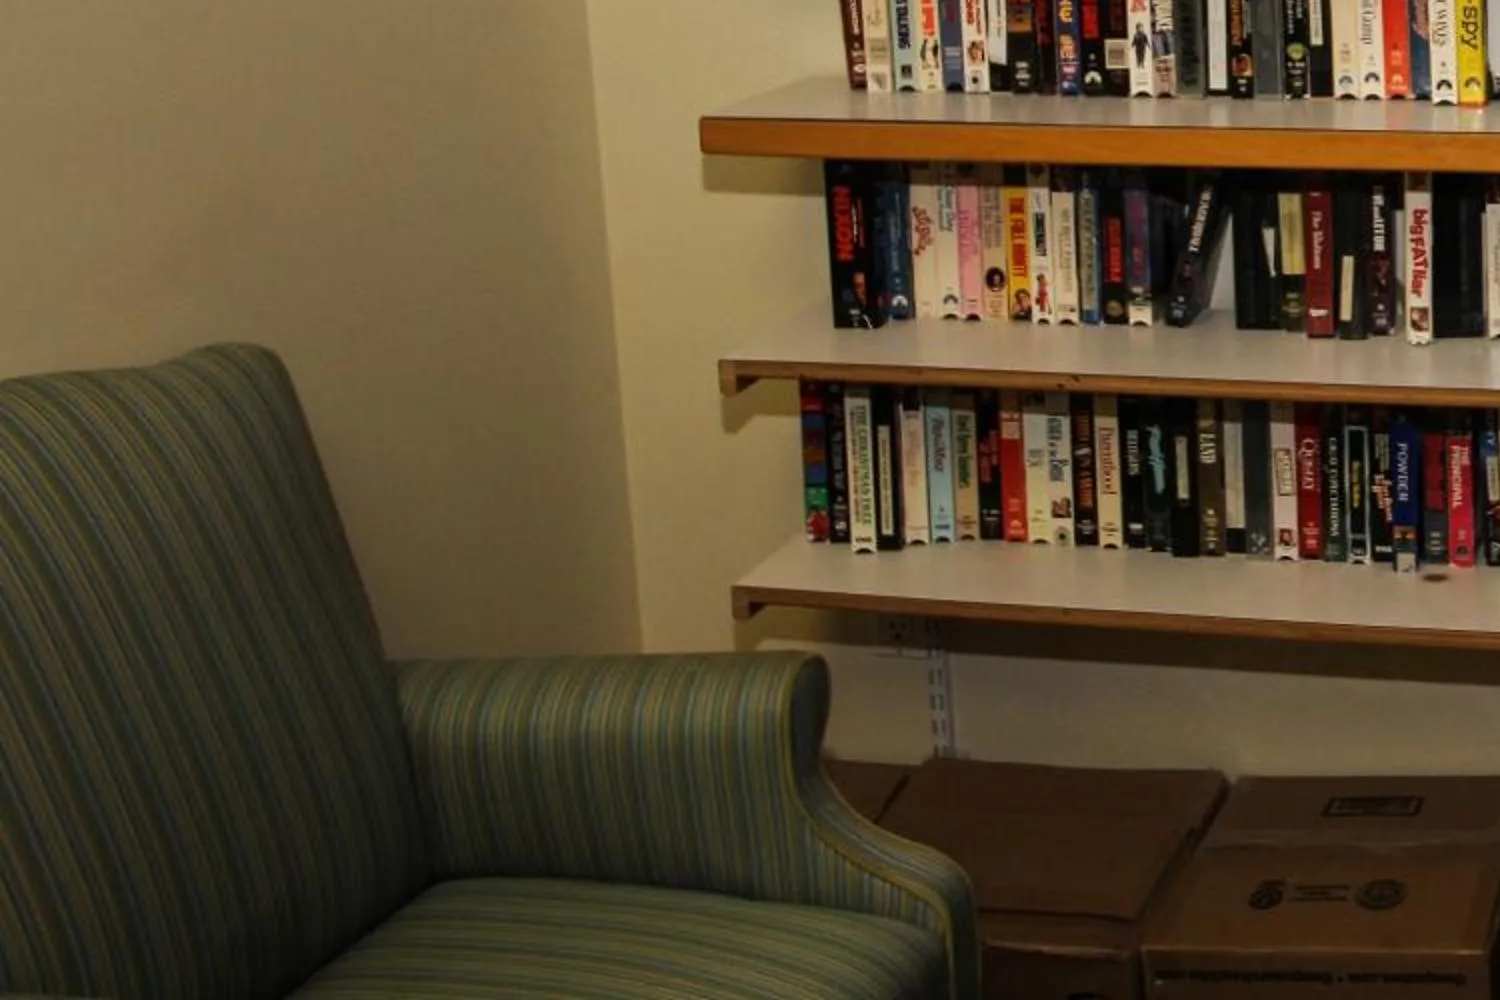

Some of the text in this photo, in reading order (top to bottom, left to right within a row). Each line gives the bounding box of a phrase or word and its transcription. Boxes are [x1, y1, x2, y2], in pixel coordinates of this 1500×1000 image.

[1357, 11, 1374, 46] Gump
[1410, 208, 1429, 236] big
[1410, 237, 1428, 268] FAT
[1397, 443, 1410, 503] POWDER
[1460, 447, 1470, 466] THE
[1451, 446, 1462, 510] PRINCIPAL
